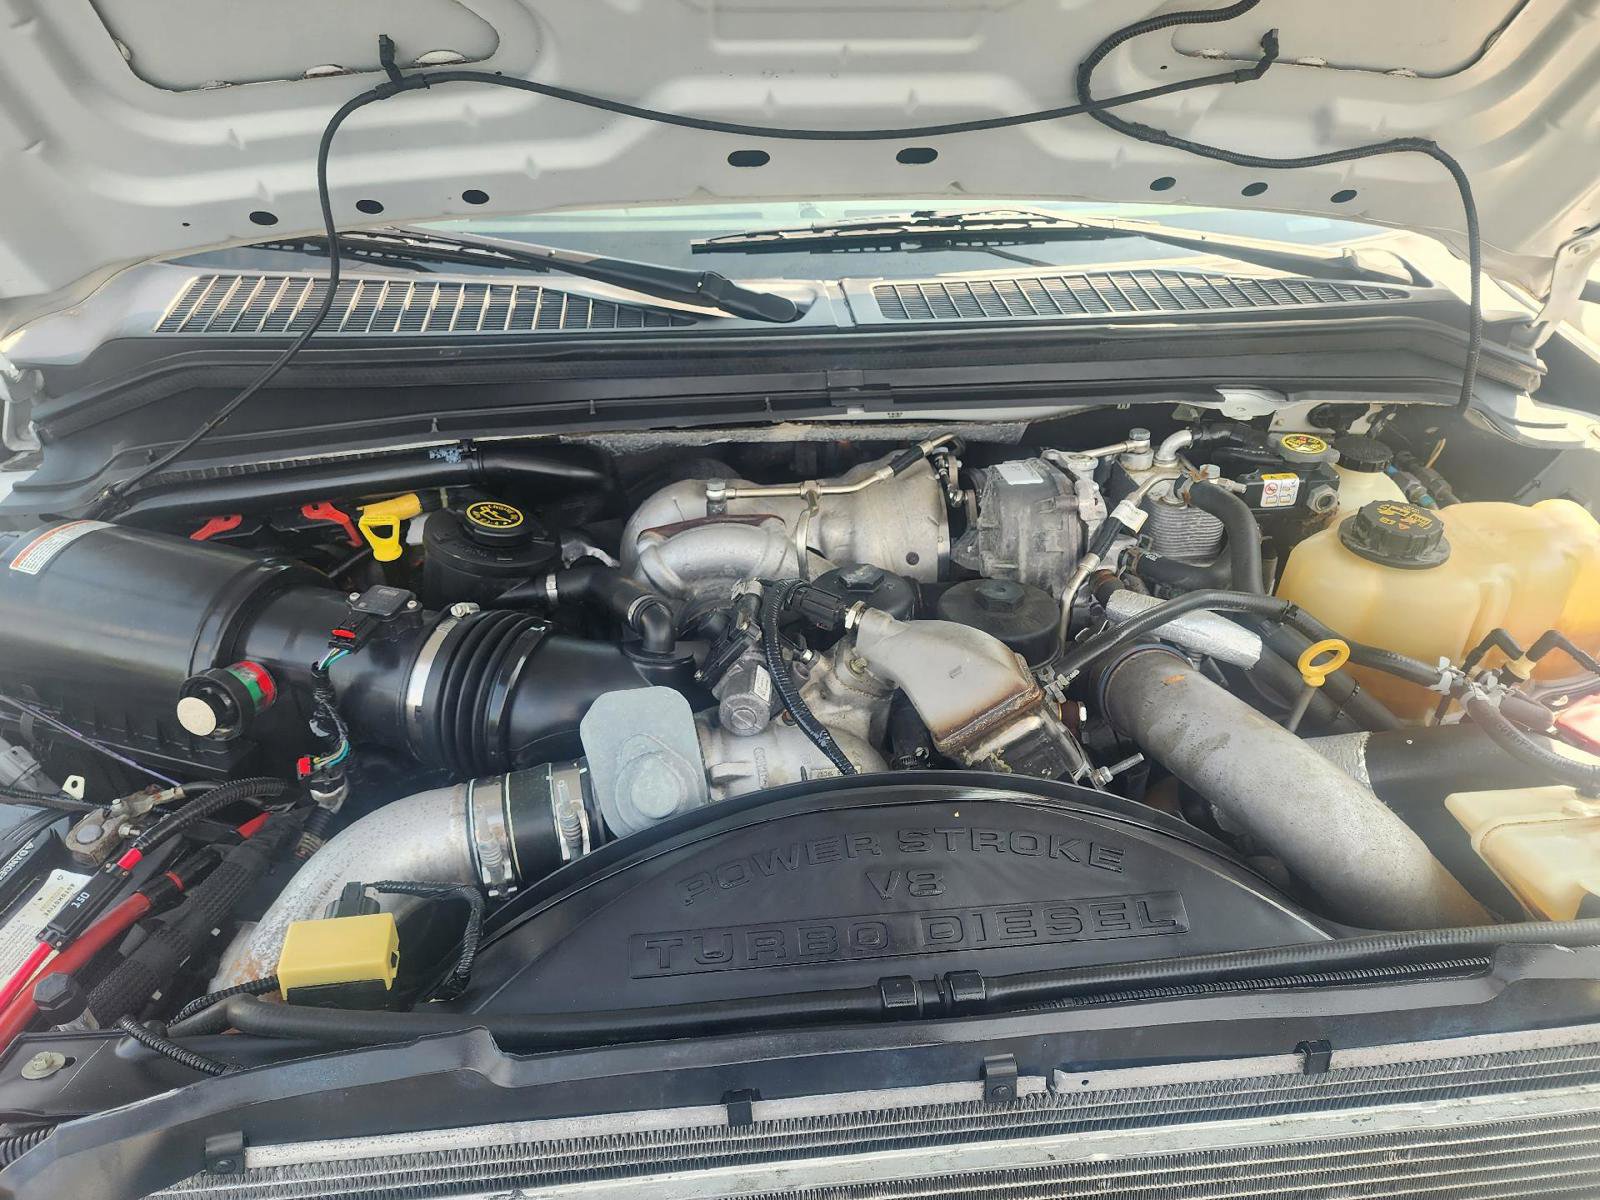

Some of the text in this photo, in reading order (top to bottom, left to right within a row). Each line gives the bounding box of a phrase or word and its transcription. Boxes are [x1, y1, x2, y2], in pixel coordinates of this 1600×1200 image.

[677, 827, 1125, 906] POWER STROKE
[865, 869, 946, 901] V8
[644, 900, 1178, 969] TURBO DIESEL
